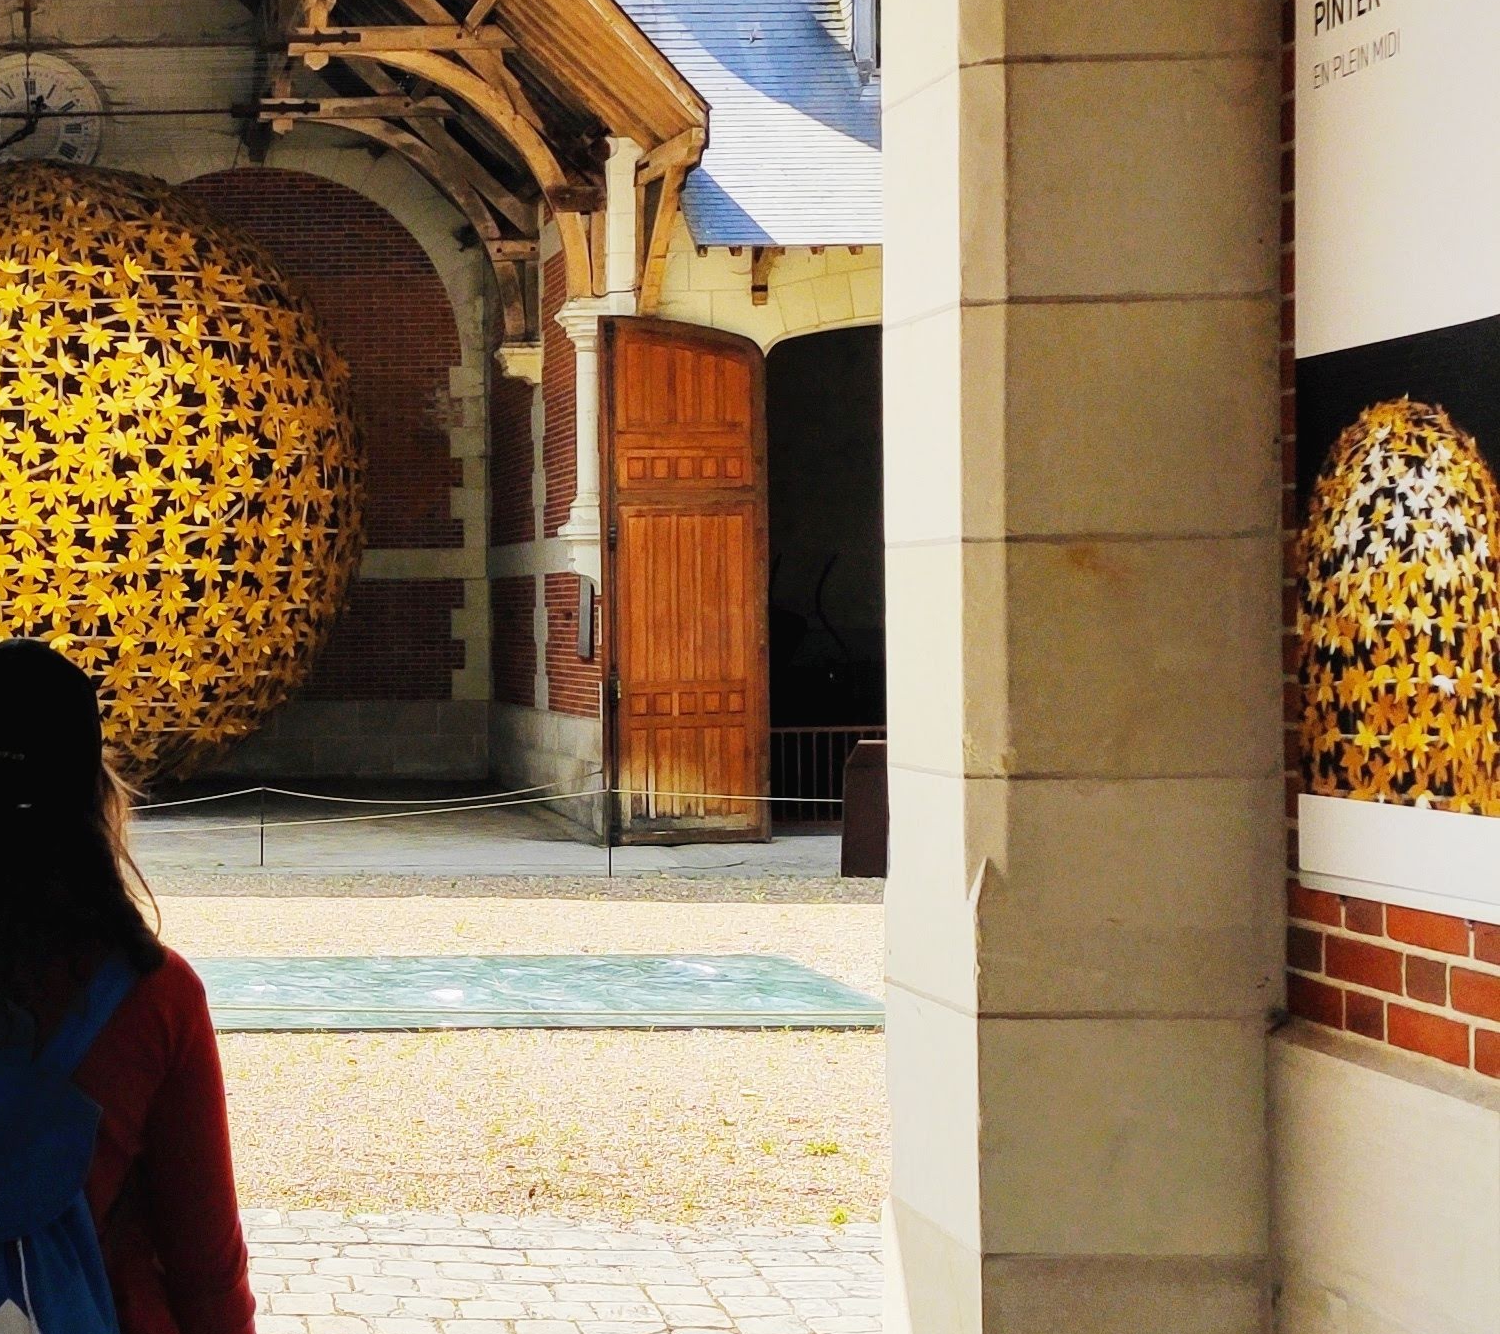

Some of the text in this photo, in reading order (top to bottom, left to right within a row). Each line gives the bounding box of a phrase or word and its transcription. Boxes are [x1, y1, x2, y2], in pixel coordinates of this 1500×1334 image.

[1314, 28, 1401, 90] EN PLEIN MIDI
